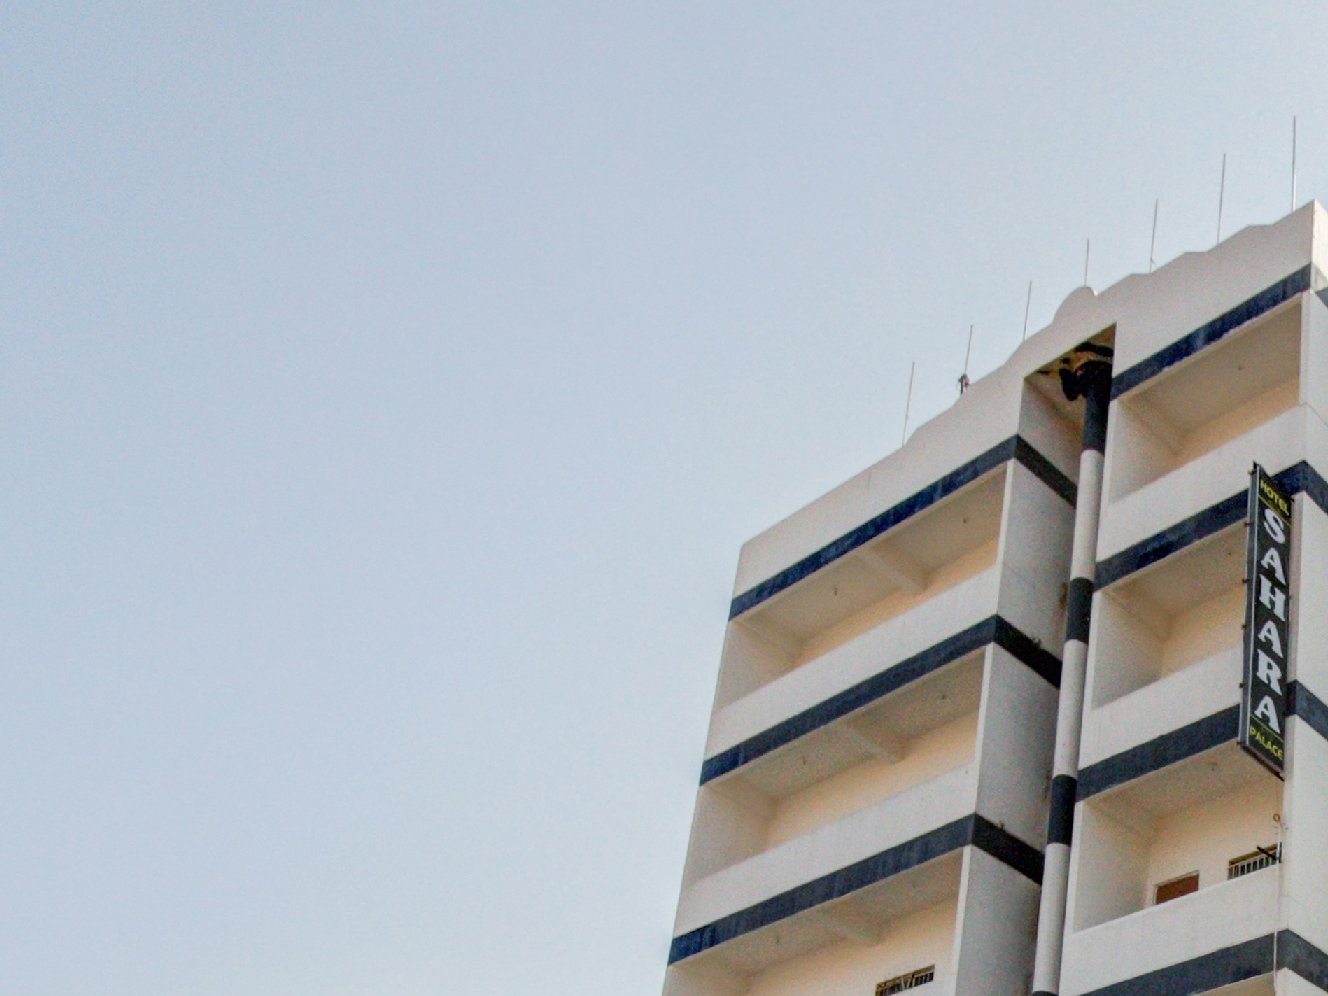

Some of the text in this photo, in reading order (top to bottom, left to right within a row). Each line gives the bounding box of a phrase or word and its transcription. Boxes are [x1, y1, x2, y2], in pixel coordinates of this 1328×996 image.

[1260, 479, 1289, 516] HOTEL
[1254, 508, 1286, 733] SAHARA
[1250, 725, 1284, 761] PALACE
